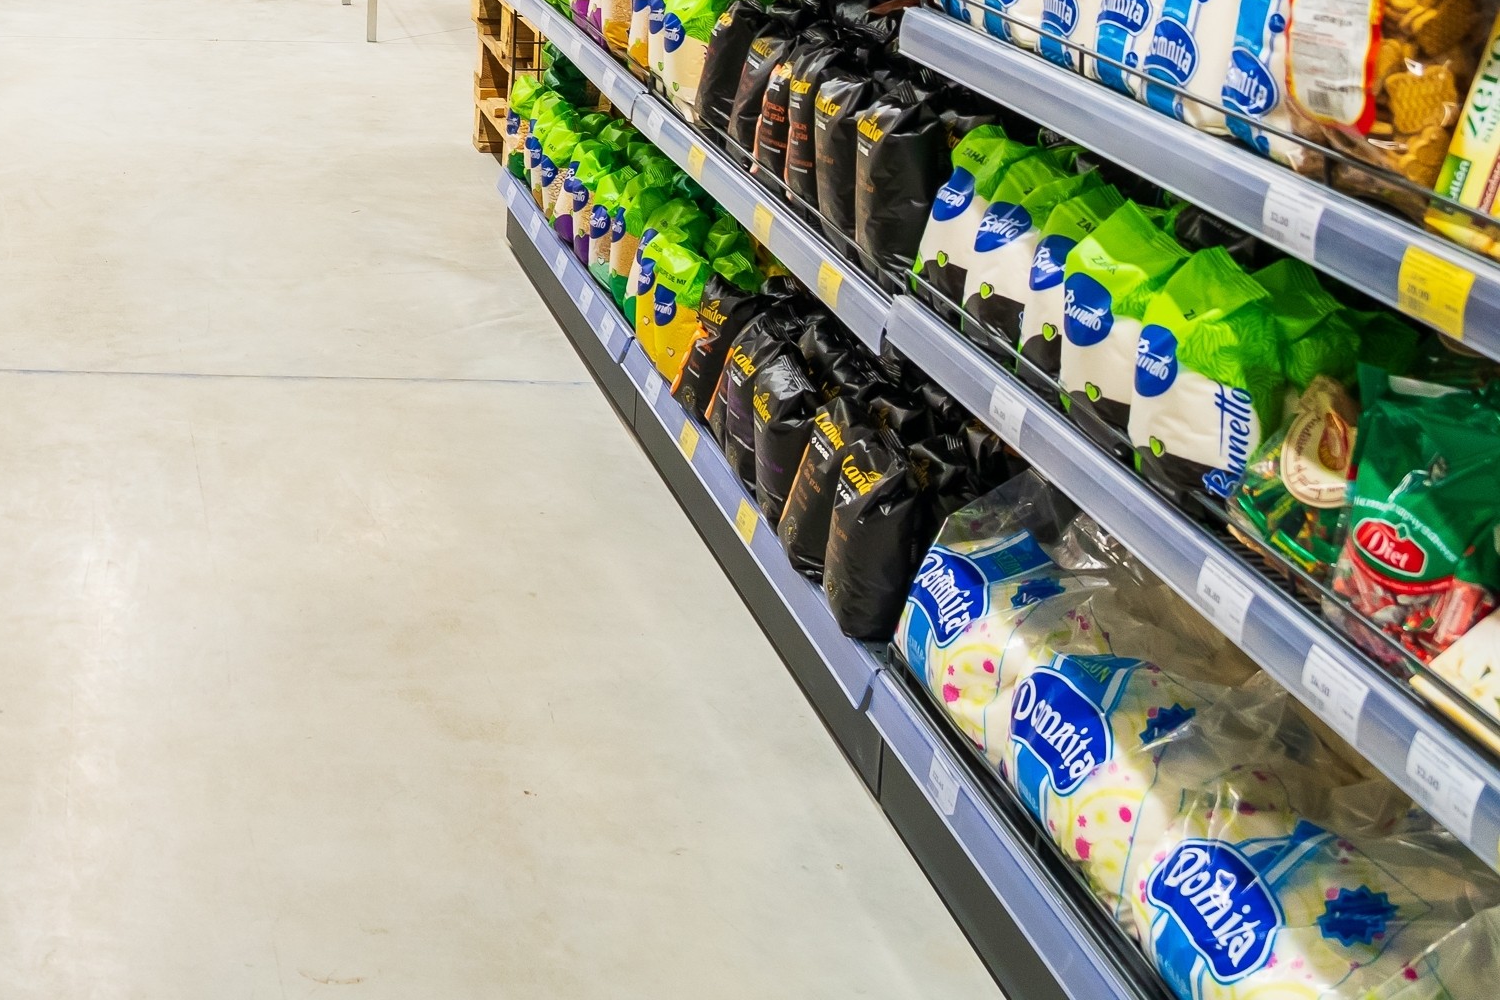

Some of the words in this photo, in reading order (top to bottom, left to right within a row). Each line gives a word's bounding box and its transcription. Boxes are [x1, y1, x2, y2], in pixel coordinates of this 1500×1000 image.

[1151, 34, 1190, 75] mnița
[1225, 67, 1268, 103] mnița
[842, 455, 876, 497] Land
[1015, 677, 1094, 783] Domnița
